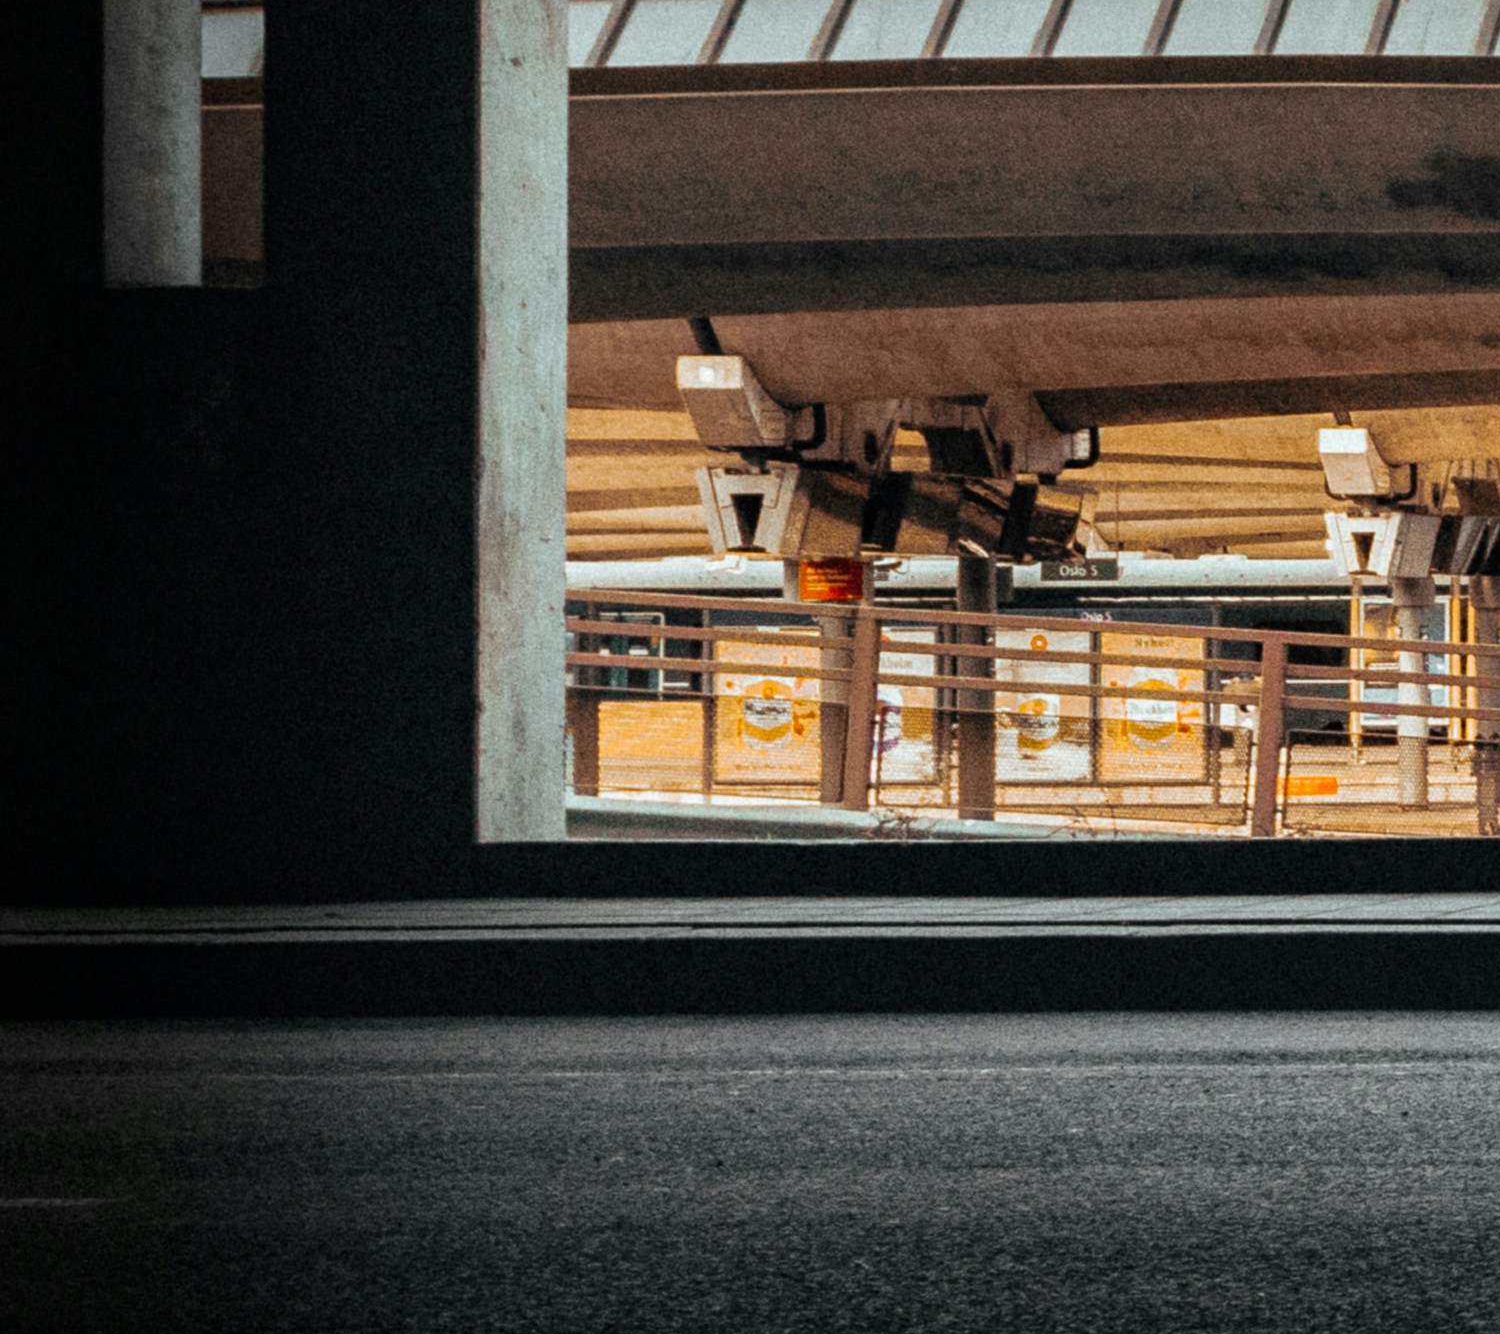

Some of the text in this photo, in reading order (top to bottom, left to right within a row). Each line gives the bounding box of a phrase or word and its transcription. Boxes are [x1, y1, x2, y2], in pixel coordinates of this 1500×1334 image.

[1059, 566, 1098, 576] Oslo S
[1081, 612, 1112, 621] Oslo S
